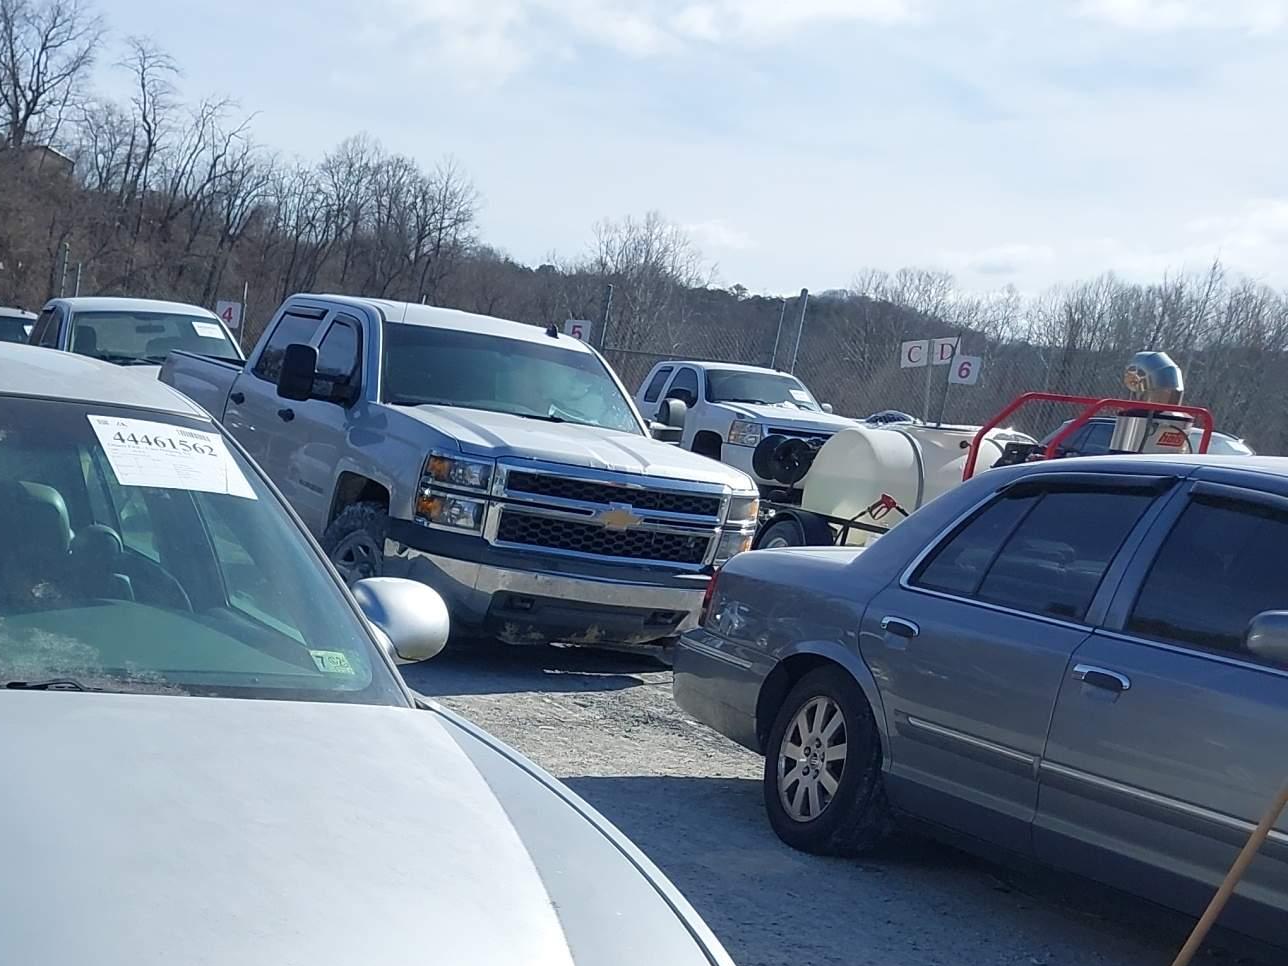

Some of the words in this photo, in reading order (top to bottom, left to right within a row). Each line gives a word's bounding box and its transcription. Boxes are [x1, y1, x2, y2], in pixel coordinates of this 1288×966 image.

[222, 306, 233, 323] 4
[571, 324, 583, 340] 5
[907, 345, 922, 363] C
[940, 342, 956, 361] D
[957, 361, 972, 379] 6
[112, 431, 218, 458] 44461562
